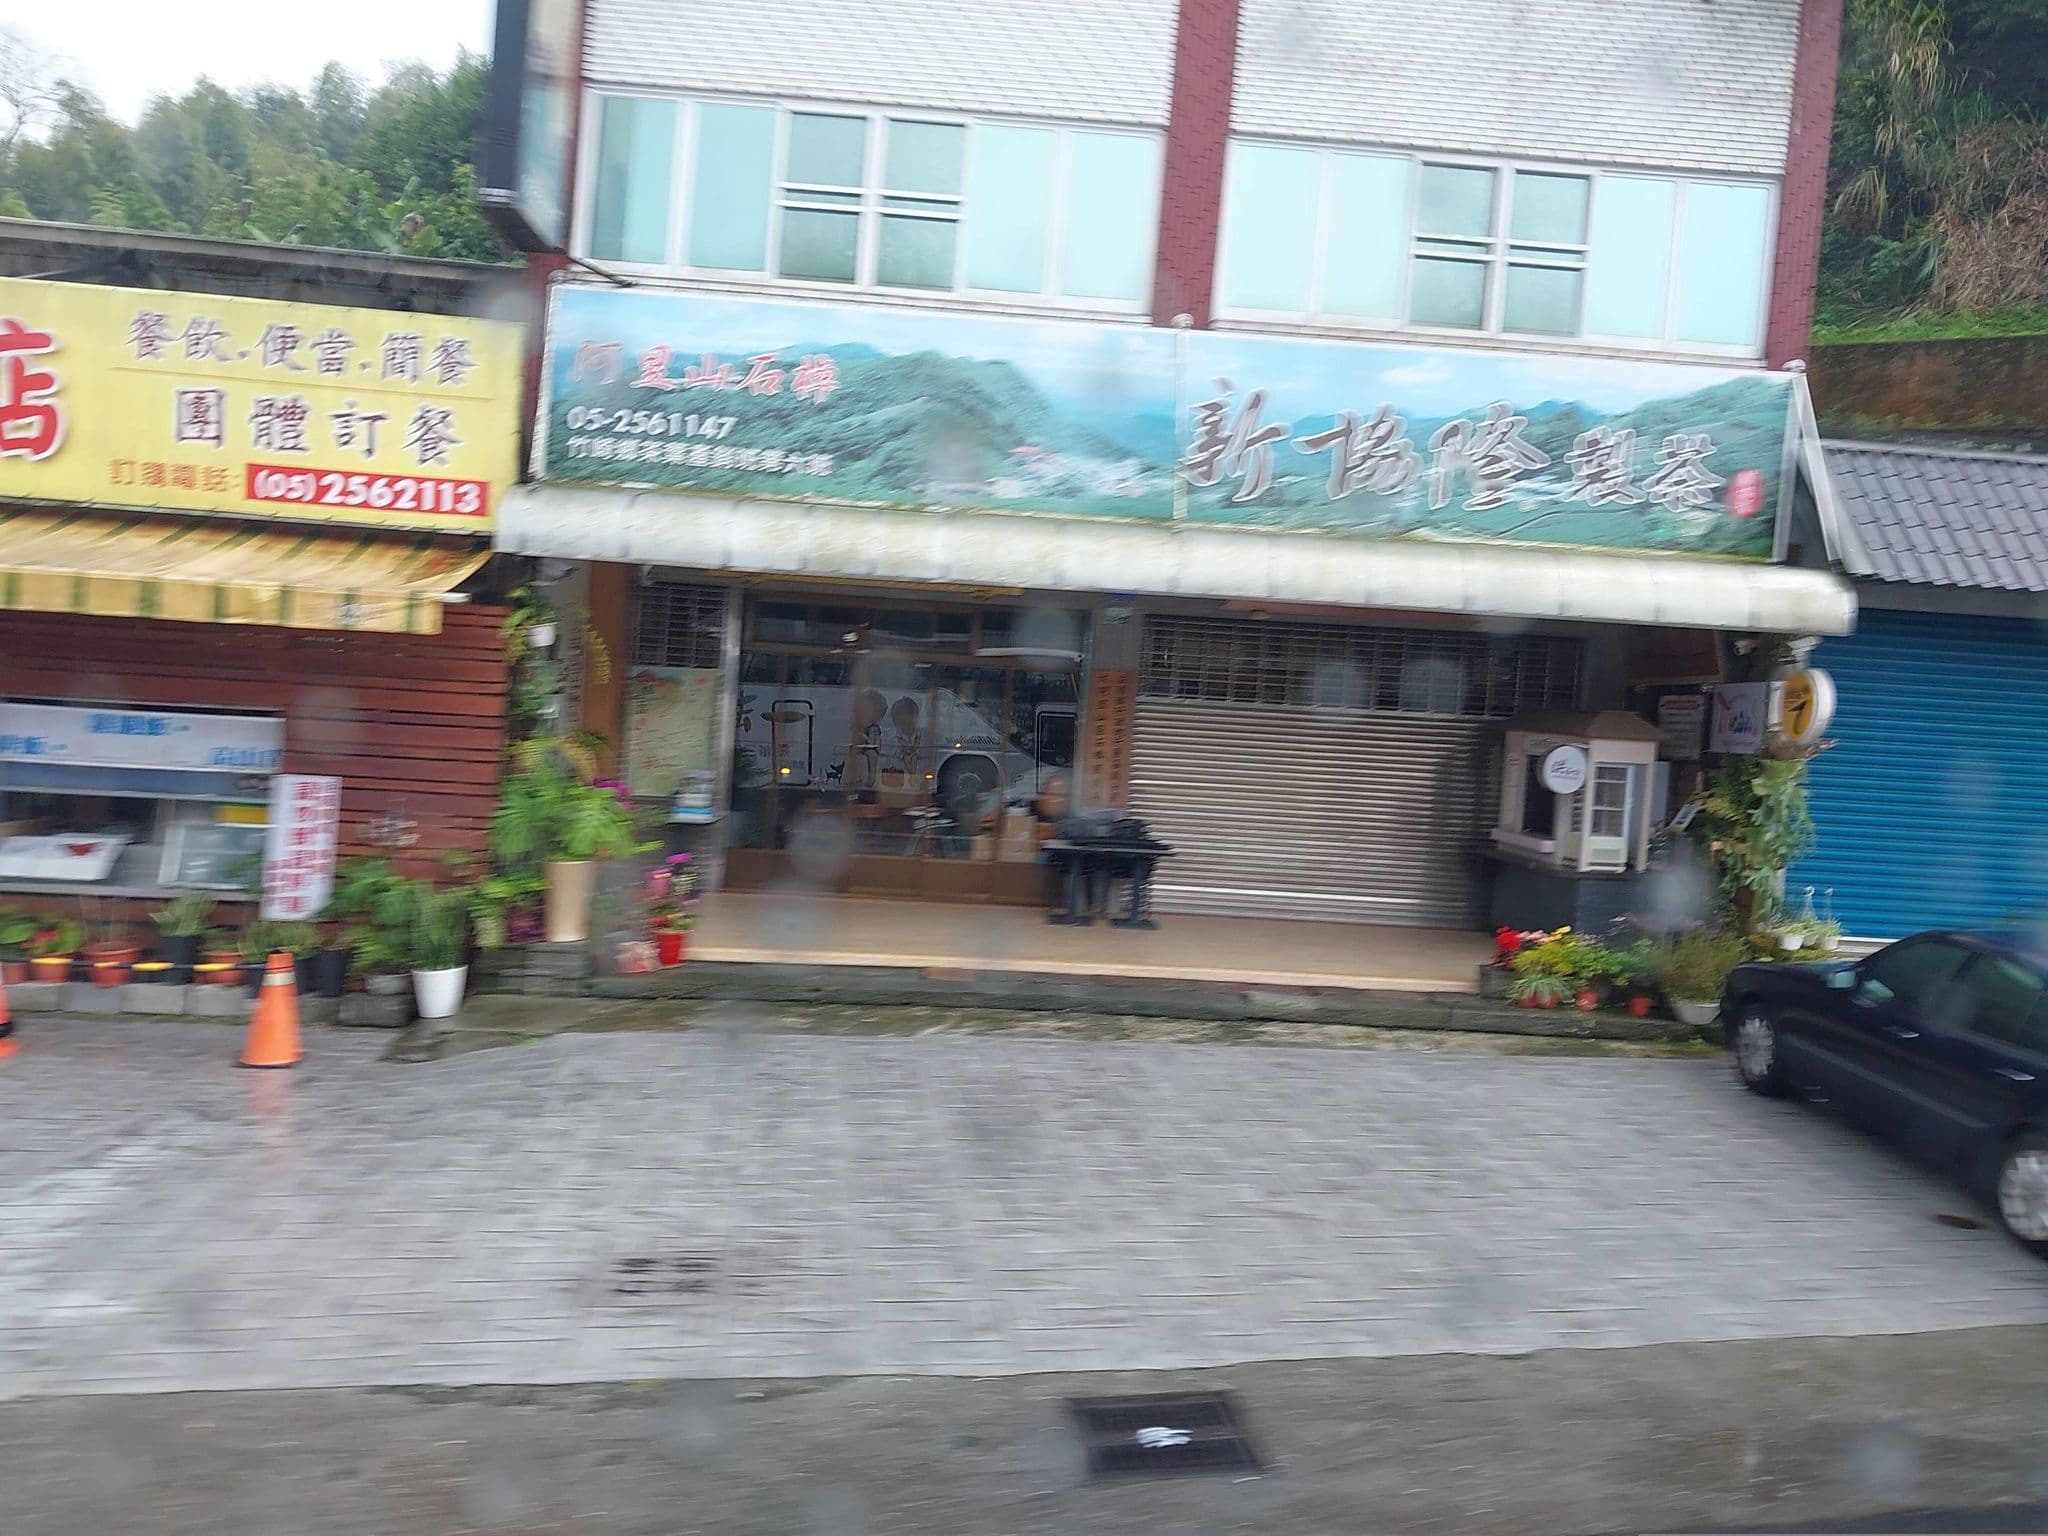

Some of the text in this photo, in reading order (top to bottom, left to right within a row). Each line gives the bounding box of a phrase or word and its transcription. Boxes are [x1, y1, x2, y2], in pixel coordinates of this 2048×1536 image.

[0, 318, 61, 460] 店
[175, 386, 465, 467] 團體訂餐
[566, 405, 738, 440] 05-2561147
[1177, 376, 1726, 514] 新協隆製茶
[253, 468, 482, 514] (05)2562113
